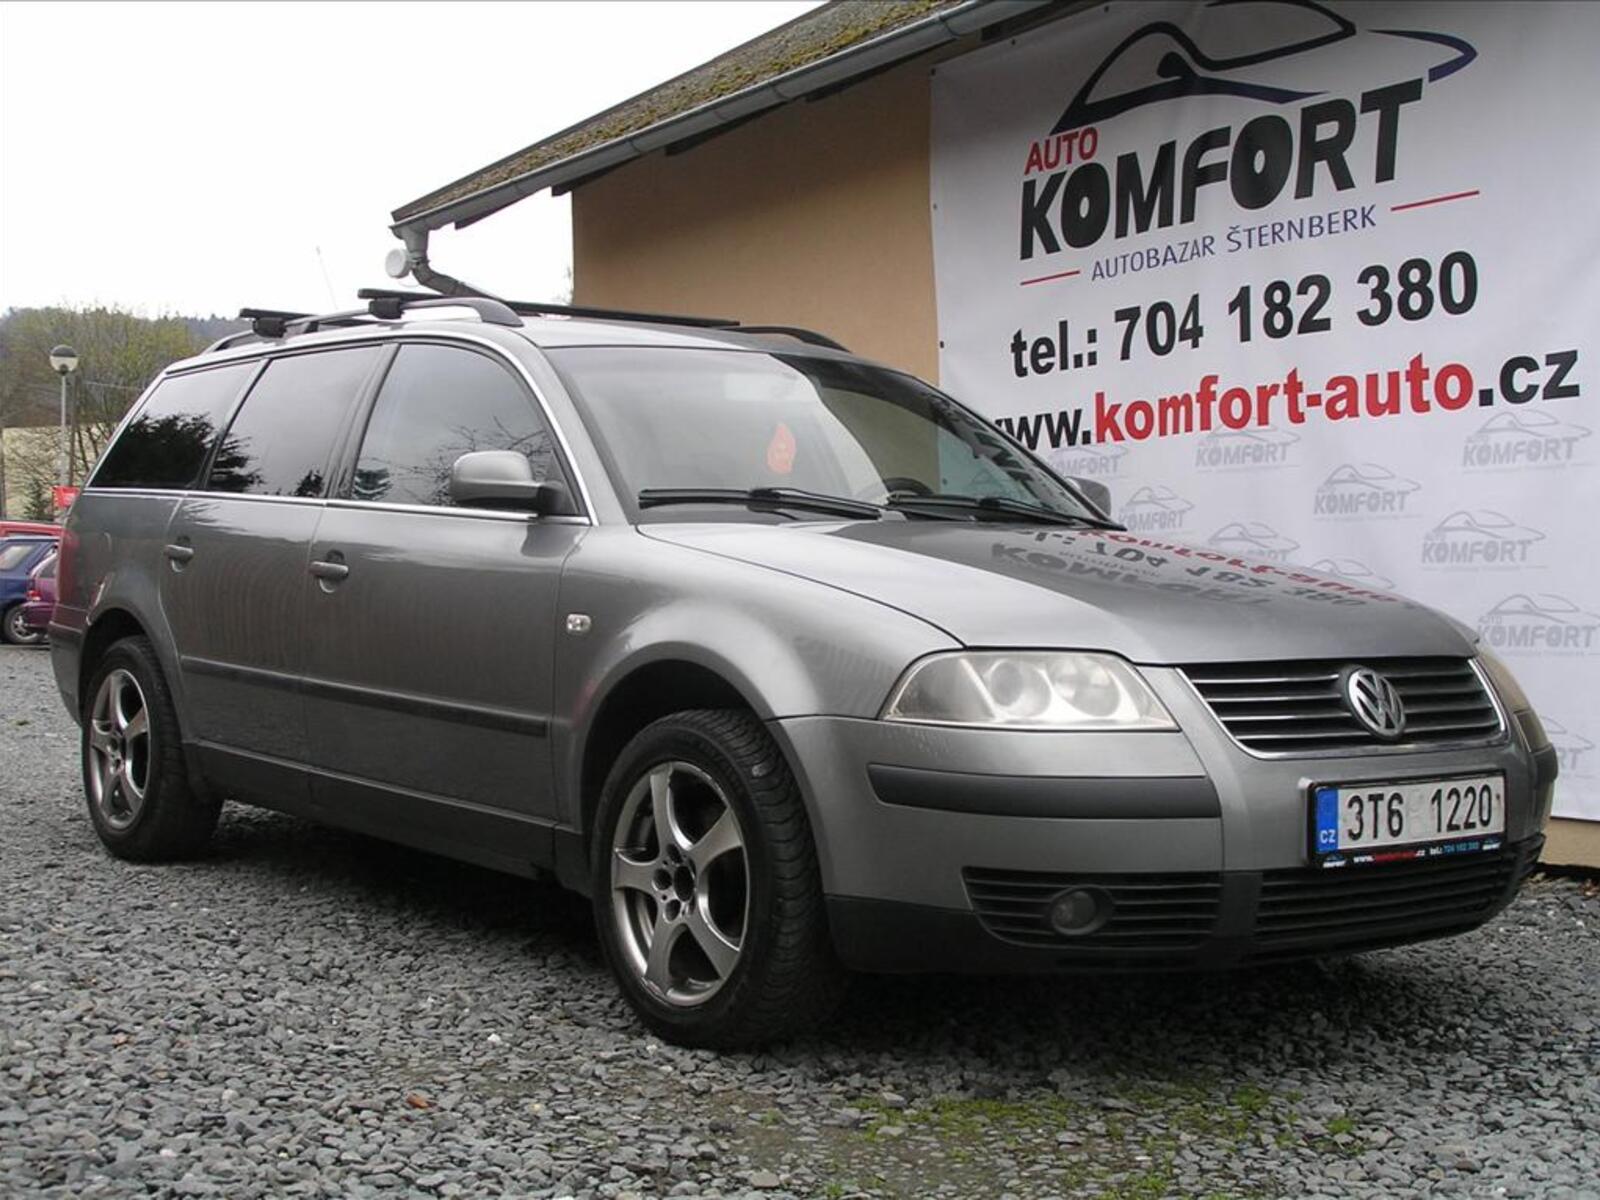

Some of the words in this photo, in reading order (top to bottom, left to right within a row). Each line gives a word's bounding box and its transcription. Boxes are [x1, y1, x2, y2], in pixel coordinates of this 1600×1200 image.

[1024, 127, 1098, 175] AUTO
[1020, 78, 1423, 260] KOMFORT
[1091, 235, 1216, 281] AUTOBAZAR
[1227, 204, 1377, 253] ŠTERNBERK
[1011, 321, 1098, 378] tel.:
[1114, 294, 1204, 361] 704
[1228, 274, 1332, 344] 182
[1357, 251, 1479, 323] 380
[1195, 443, 1291, 467] KOMFORT
[1463, 437, 1579, 467] KOMFORT
[1313, 491, 1411, 515] KOMFORT
[1118, 509, 1187, 531] KOMFORT
[1421, 541, 1533, 564] KOMFORT
[1347, 793, 1404, 841] 3T6
[1431, 784, 1492, 833] 1220
[1320, 829, 1336, 844] CZ
